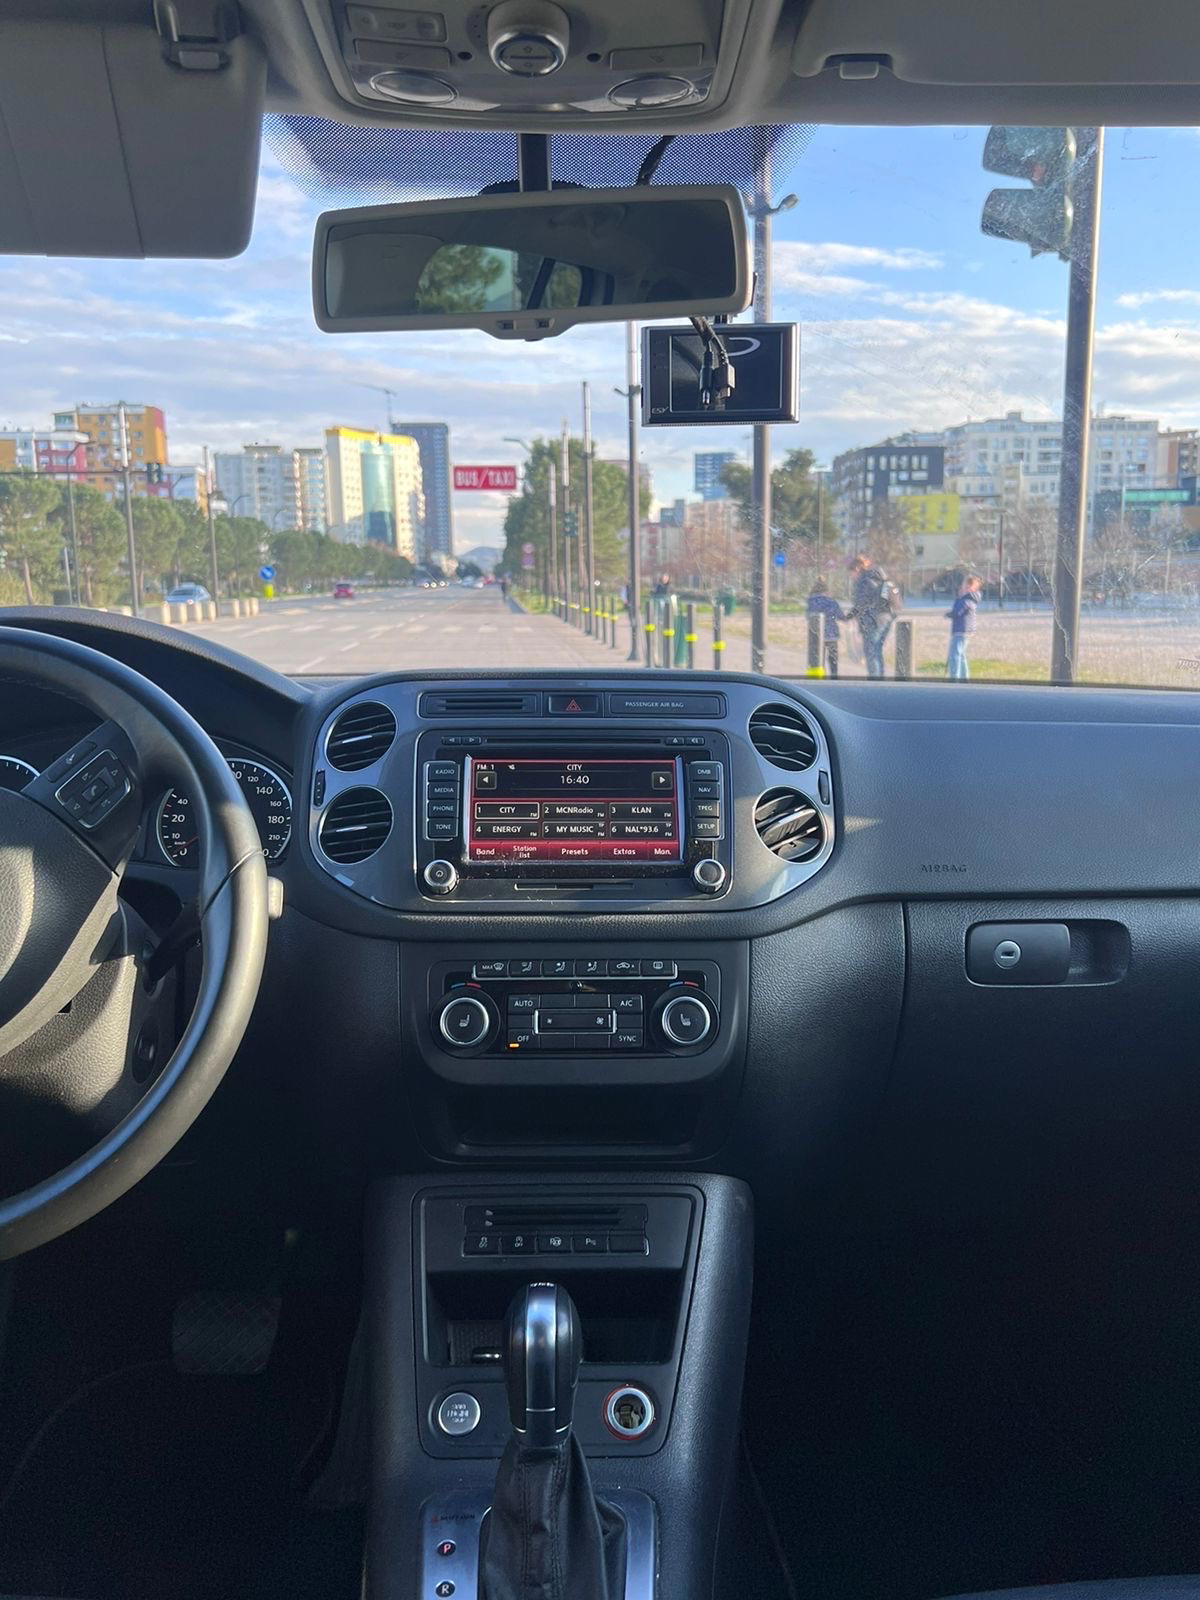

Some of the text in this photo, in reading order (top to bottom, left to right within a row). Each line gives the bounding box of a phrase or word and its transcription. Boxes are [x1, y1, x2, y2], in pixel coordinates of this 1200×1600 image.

[560, 775, 590, 784] 16:40
[256, 786, 273, 795] 140
[171, 814, 185, 823] 20
[267, 815, 285, 824] 180
[492, 825, 521, 833] ENERGY
[544, 825, 594, 833] 5 MY MUSIC
[611, 825, 617, 833] 6
[920, 864, 967, 873] AIRBAG
[443, 1543, 451, 1554] P
[441, 1584, 450, 1595] R
